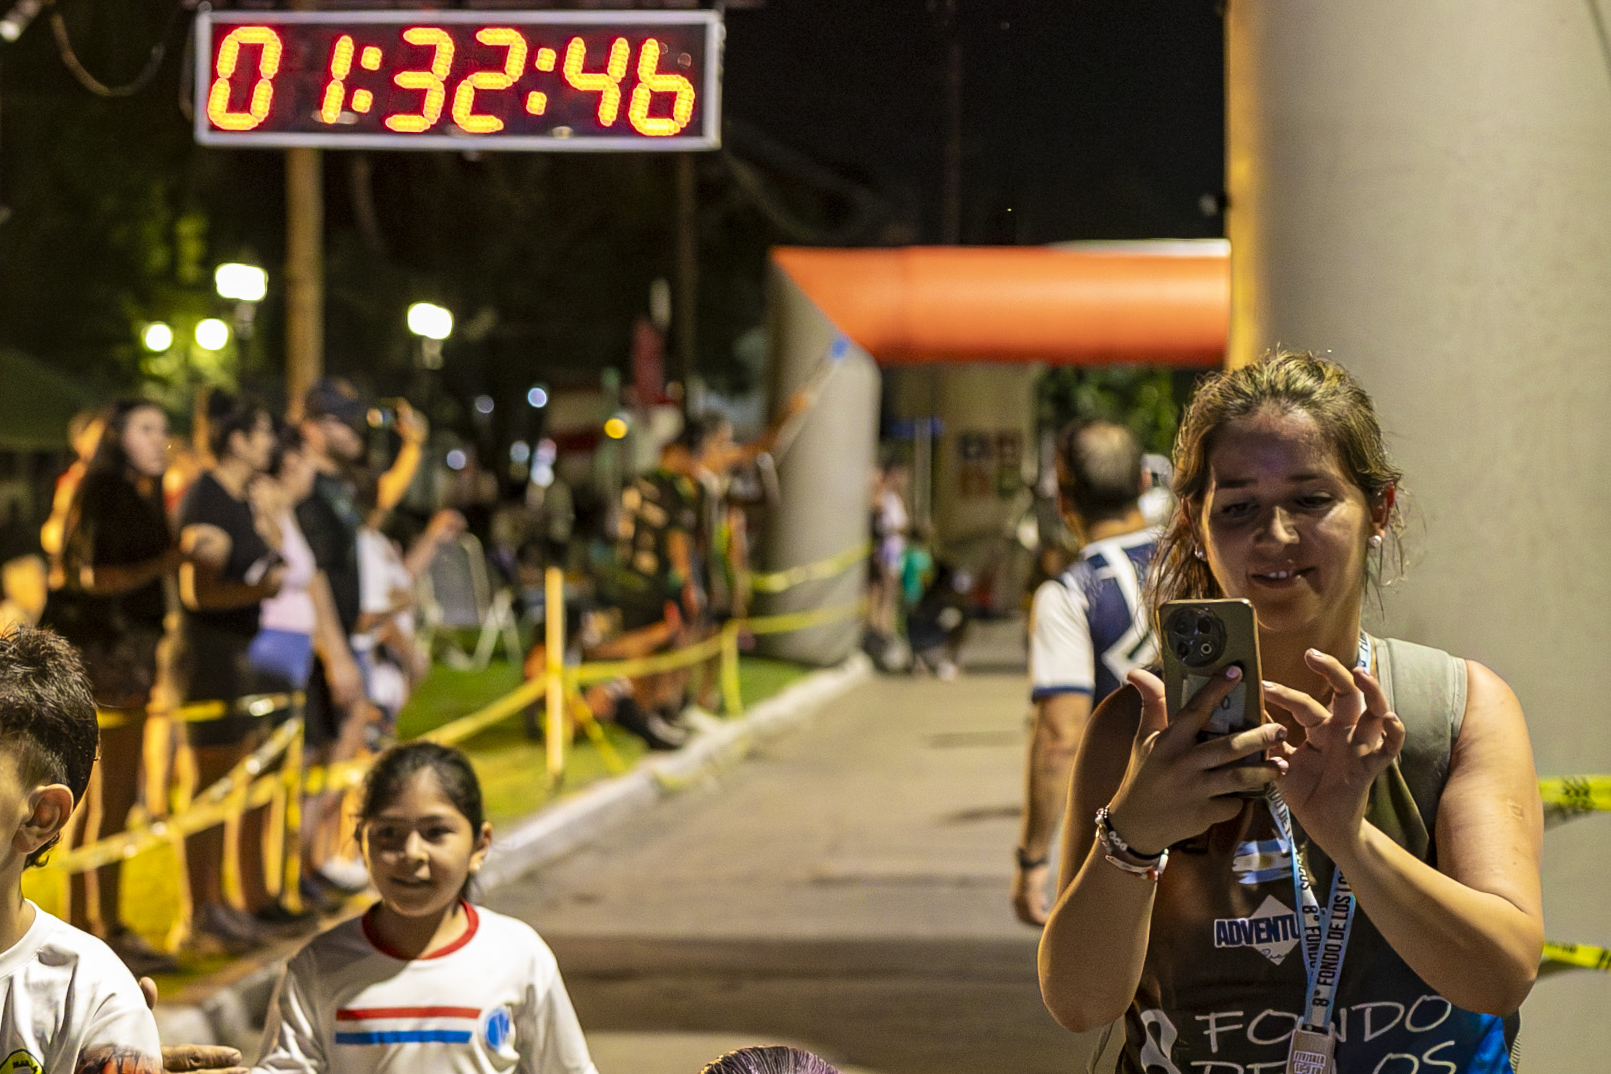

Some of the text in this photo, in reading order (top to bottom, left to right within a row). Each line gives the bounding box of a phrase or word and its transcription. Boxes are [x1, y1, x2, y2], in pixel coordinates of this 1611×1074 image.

[208, 26, 695, 136] 01:32:46
[1333, 895, 1352, 921] LOS
[1326, 922, 1346, 940] DE
[1317, 943, 1344, 986] FONDO
